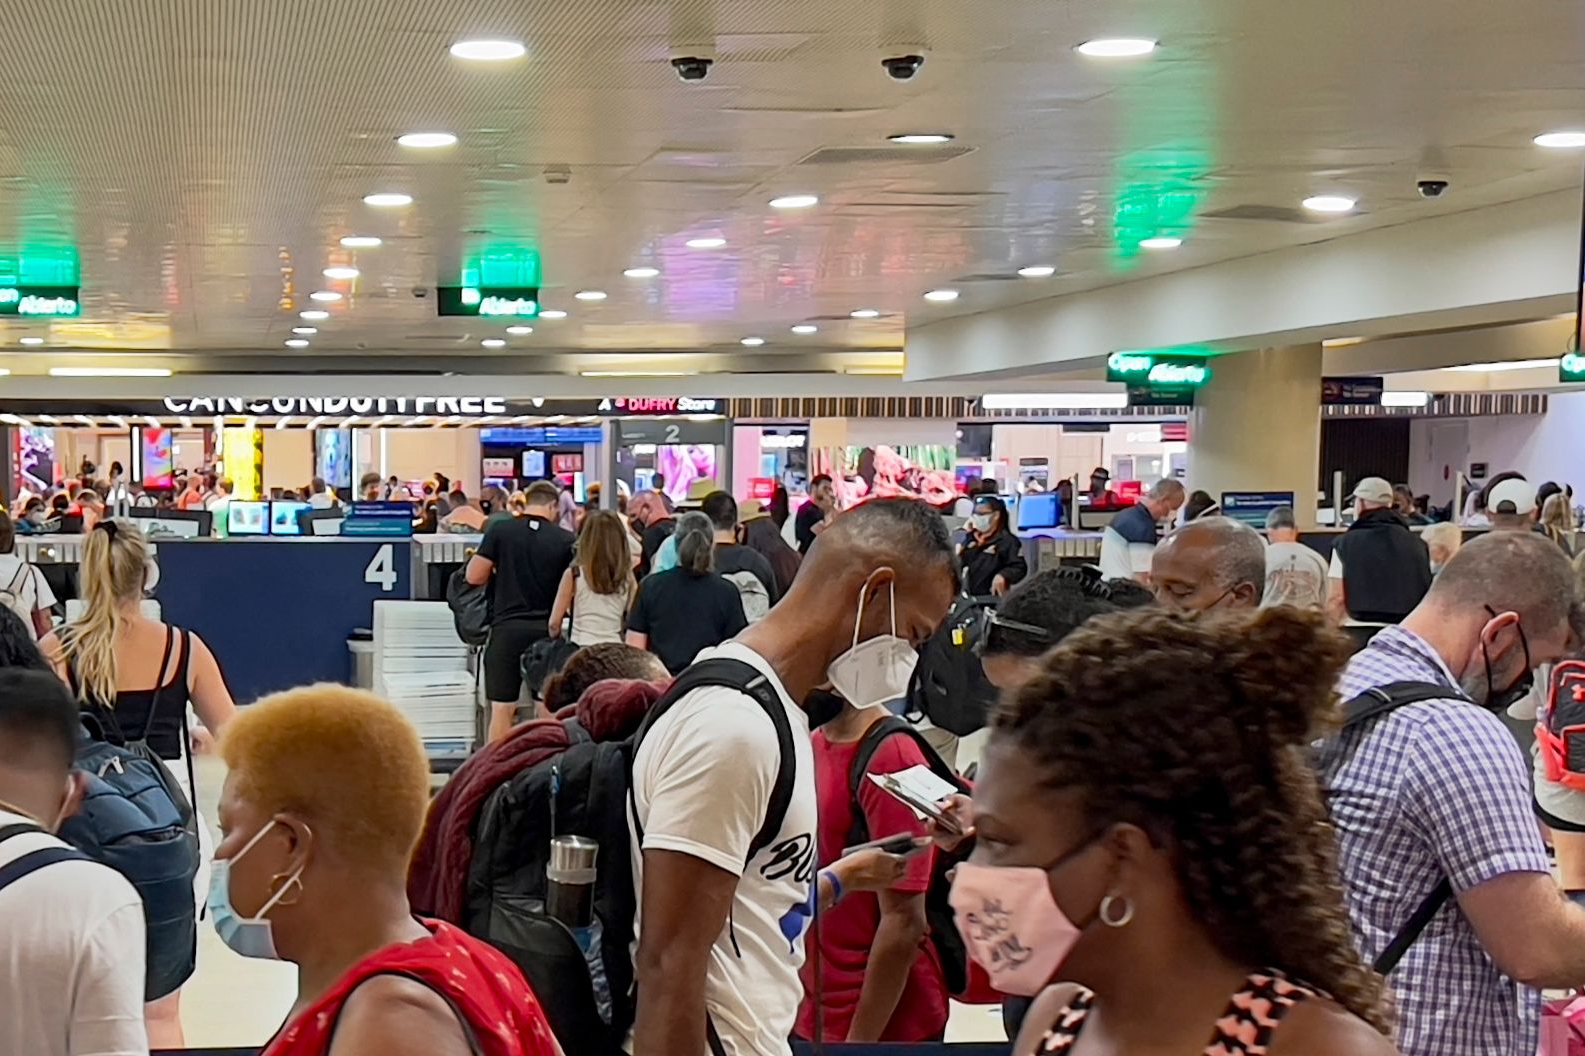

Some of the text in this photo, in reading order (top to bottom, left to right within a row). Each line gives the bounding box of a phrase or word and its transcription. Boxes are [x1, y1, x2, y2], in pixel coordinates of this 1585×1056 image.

[628, 396, 676, 411] DUFRY
[665, 424, 680, 443] 2
[365, 543, 397, 592] 4
